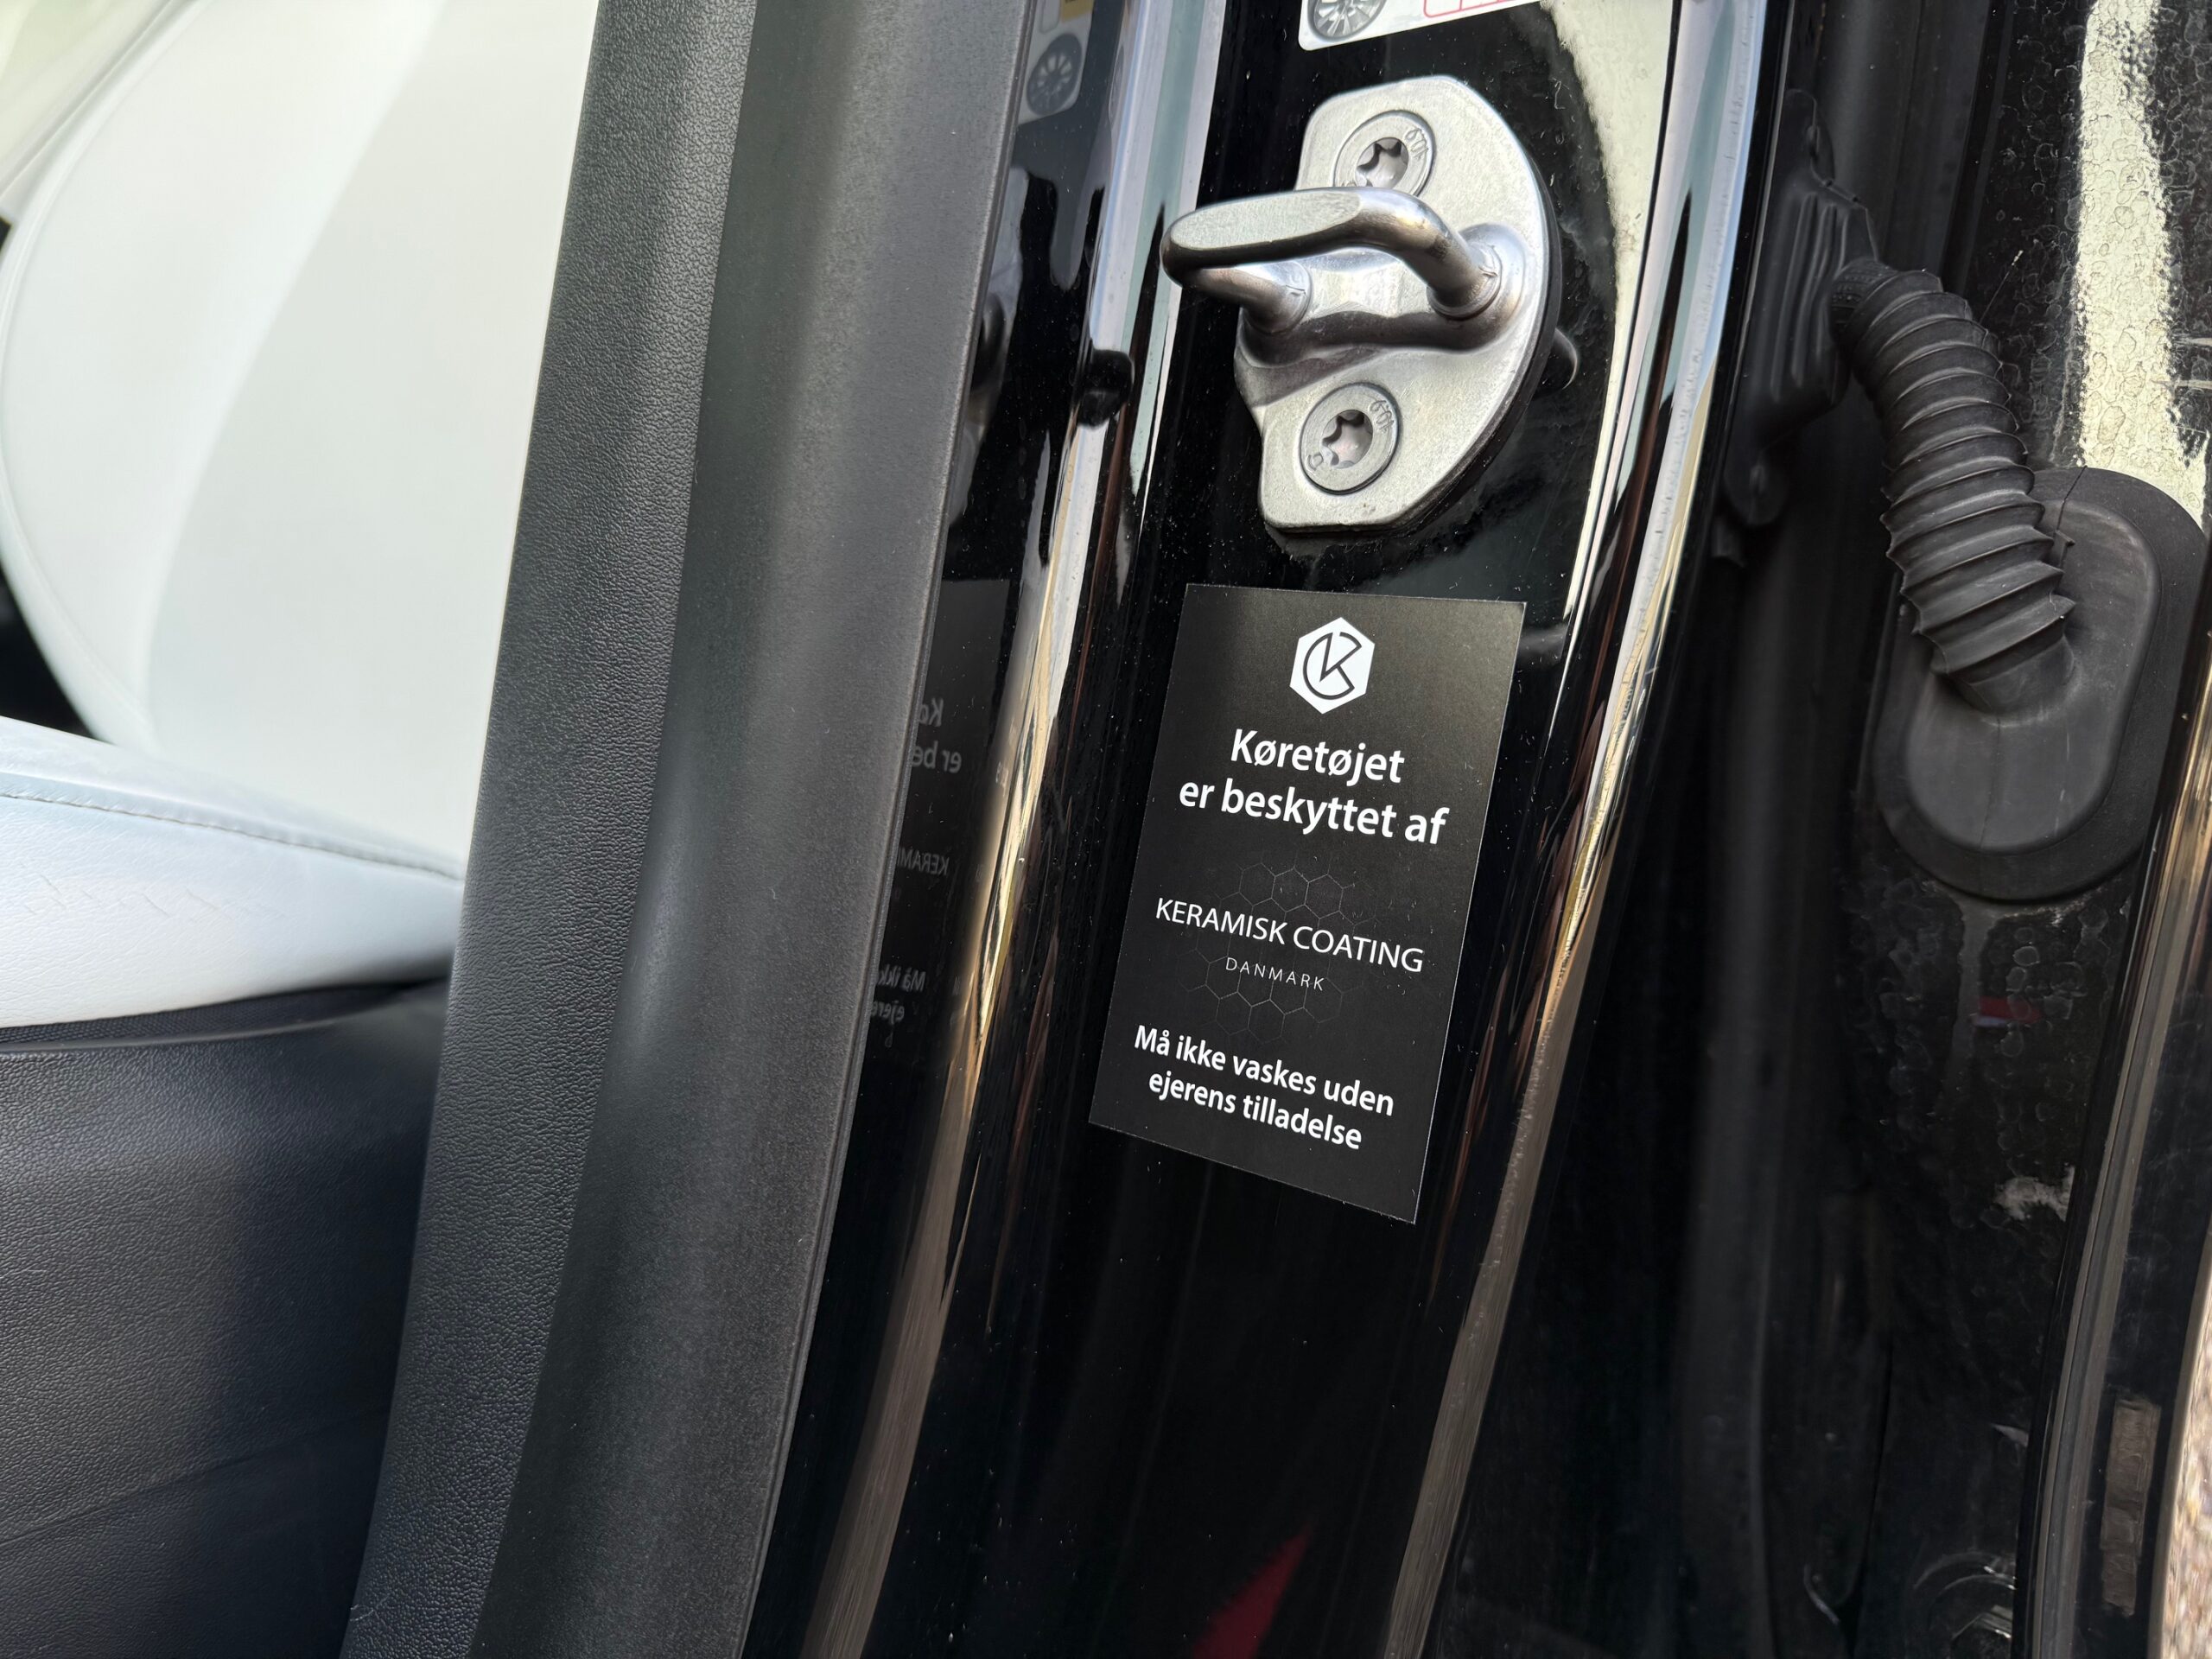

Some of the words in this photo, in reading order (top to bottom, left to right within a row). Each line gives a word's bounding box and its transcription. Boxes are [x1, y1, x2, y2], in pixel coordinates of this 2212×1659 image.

[1230, 728, 1406, 787] Køretøjet
[1179, 782, 1216, 809] er
[1221, 777, 1397, 838] beskyttet
[1404, 806, 1451, 845] af
[1155, 897, 1288, 945] KERAMISK
[1293, 925, 1424, 973] COATING
[1225, 957, 1325, 991] DANMARK
[1134, 1024, 1171, 1057] Må
[1175, 1035, 1226, 1071] ikke
[1232, 1055, 1317, 1096] vaskes
[1323, 1079, 1394, 1116] uden
[1148, 1071, 1236, 1114] ejerens
[1243, 1094, 1362, 1150] tilladelse
